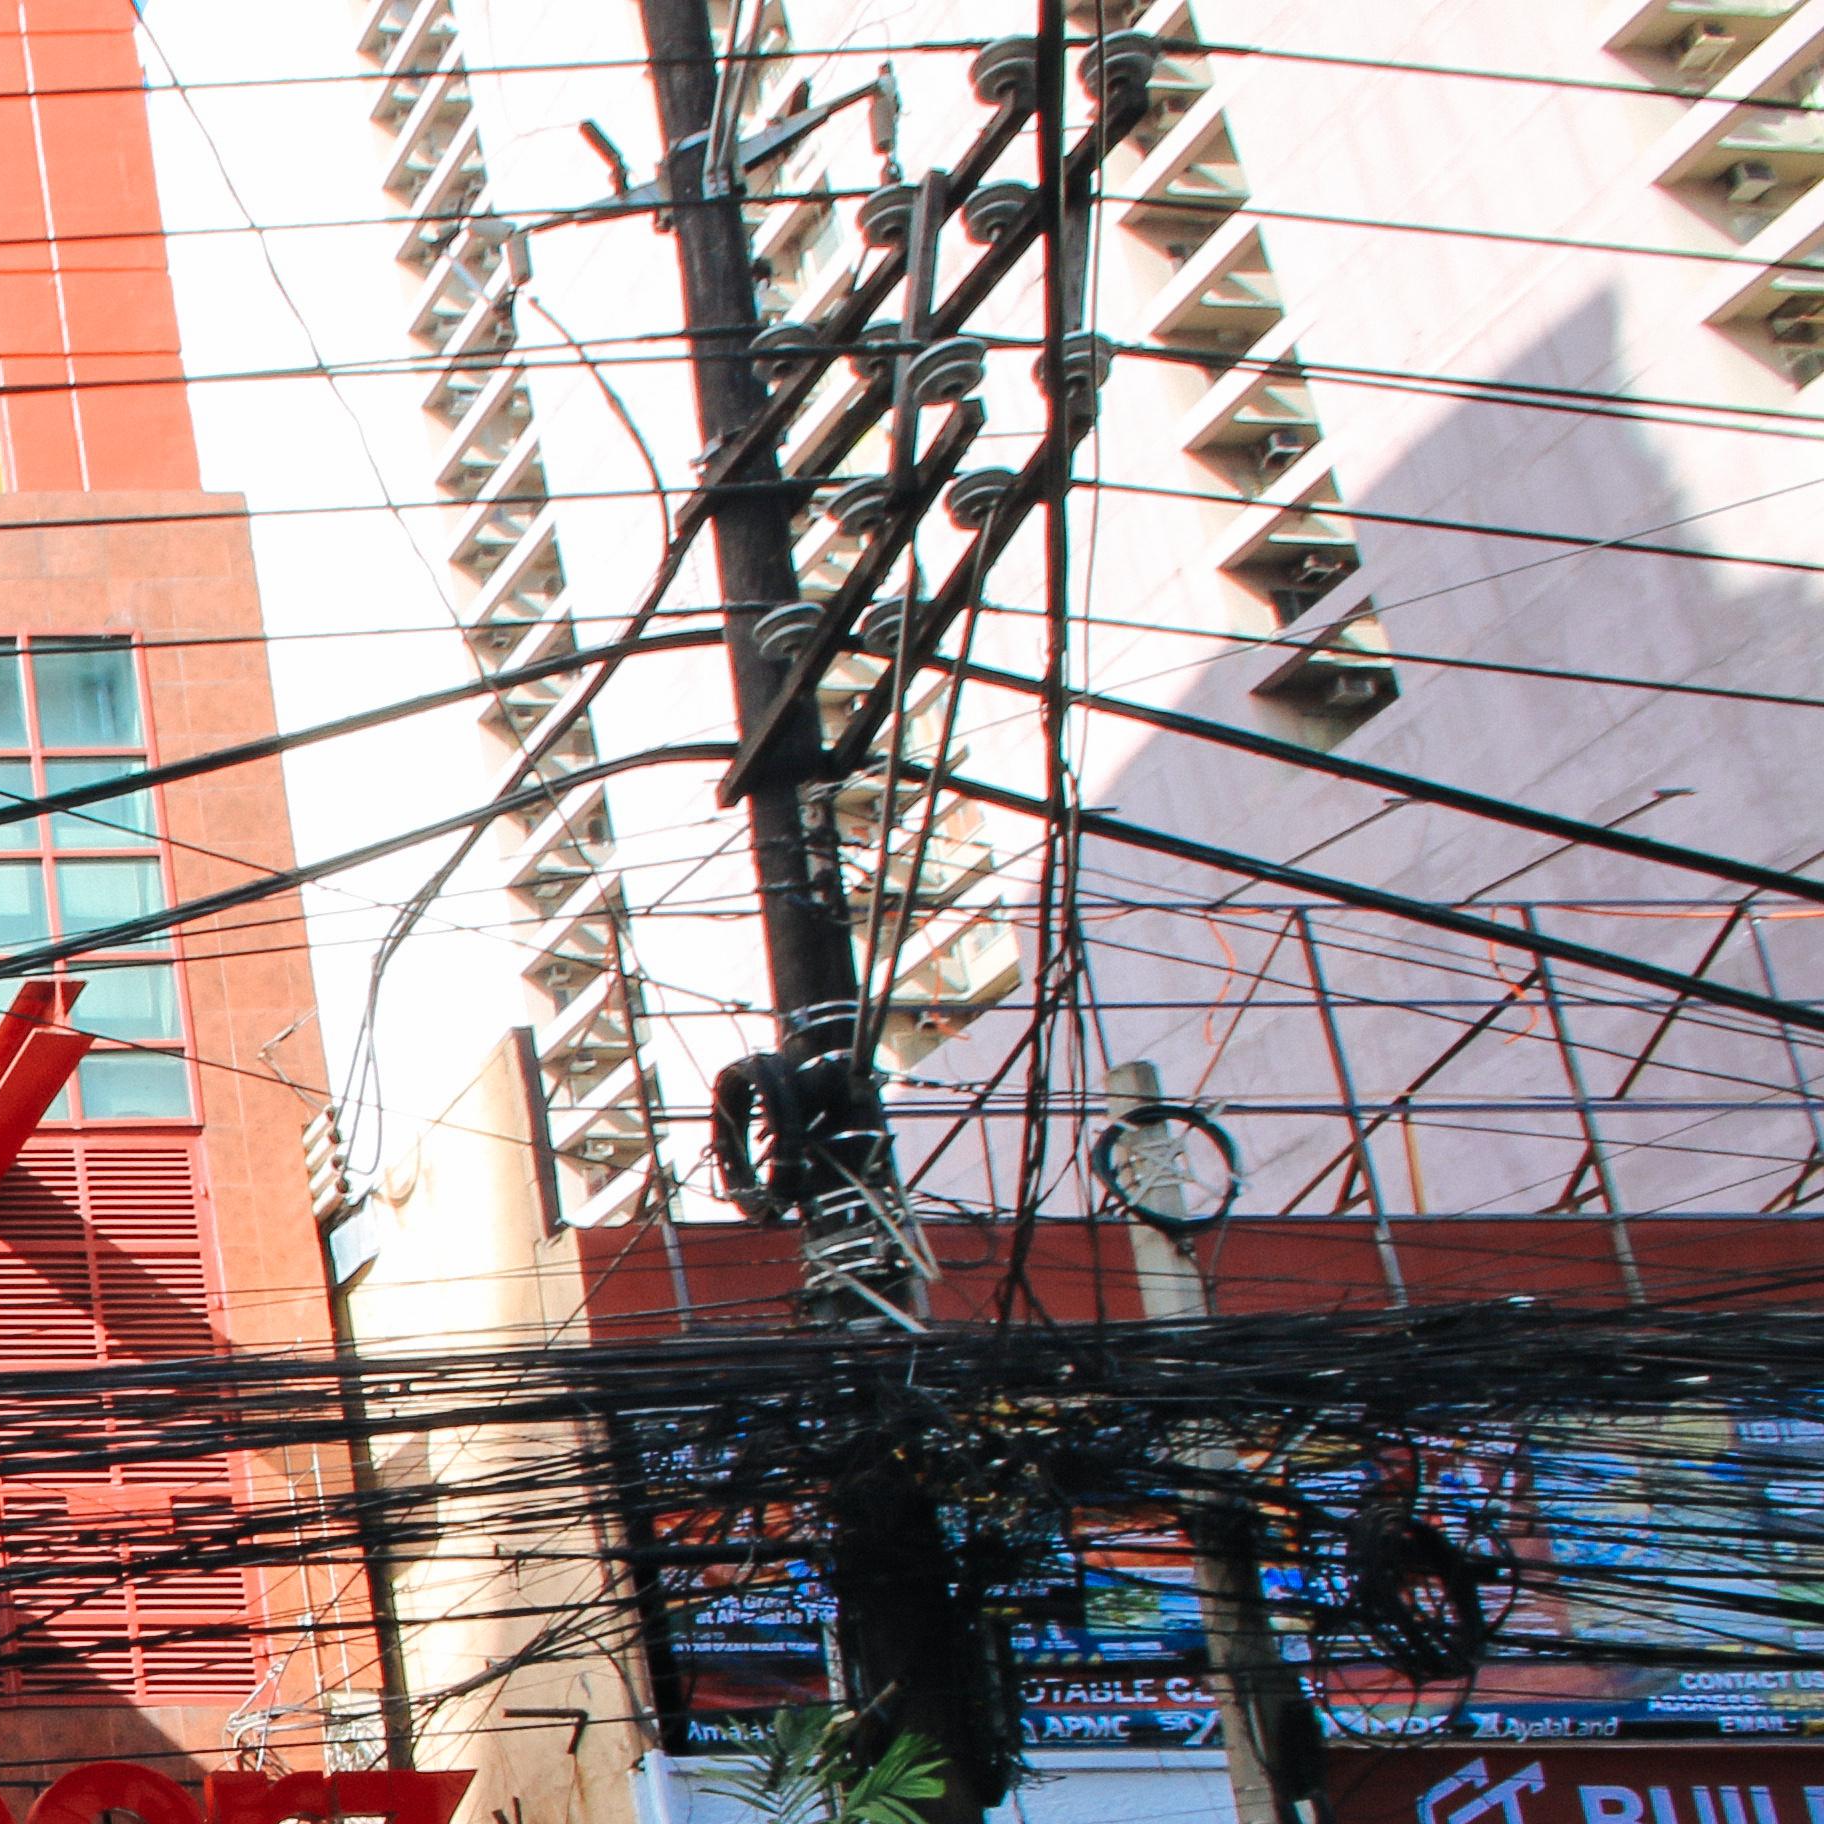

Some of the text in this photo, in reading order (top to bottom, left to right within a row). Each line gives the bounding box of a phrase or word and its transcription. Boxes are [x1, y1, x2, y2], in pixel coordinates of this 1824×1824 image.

[1679, 1671, 1791, 1690] CONTACT
[1042, 1715, 1132, 1738] APMC
[1504, 1716, 1618, 1743] AyalaLand
